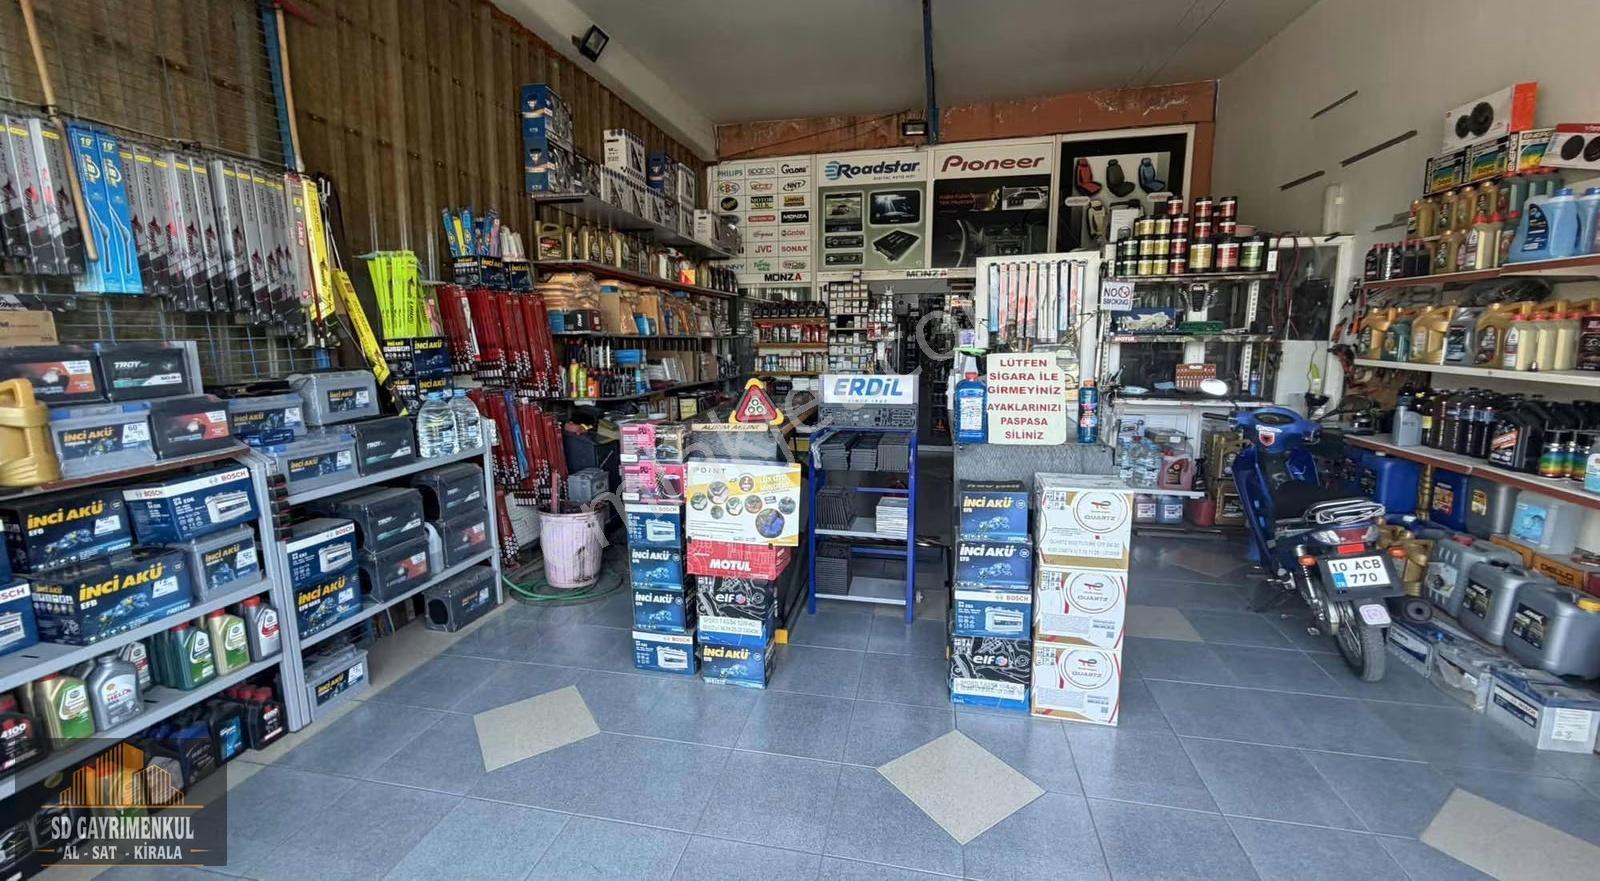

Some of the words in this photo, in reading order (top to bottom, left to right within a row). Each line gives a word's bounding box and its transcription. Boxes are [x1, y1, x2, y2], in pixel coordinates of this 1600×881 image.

[941, 155, 1045, 172] Pioneer
[717, 169, 743, 177] PHILIPS
[837, 160, 920, 179] Roadstar
[755, 245, 772, 253] JVC
[781, 245, 808, 253] SONAX
[764, 273, 802, 281] MONZA
[906, 270, 948, 278] MONZA
[1103, 287, 1118, 297] NO
[113, 360, 141, 369] TROY
[1000, 357, 1048, 367] LÜTFEN
[989, 371, 1034, 381] SİGARA
[1039, 371, 1059, 381] İLE
[987, 384, 1061, 395] GİRMEYİNİZ
[987, 403, 1062, 412] AYAKLARINIZI
[1000, 417, 1048, 426] PASPASA
[1005, 429, 1045, 440] SİLİNİZ
[221, 470, 247, 482] BOSCH
[709, 559, 752, 571] MOTUL
[1332, 563, 1348, 572] 10
[1355, 559, 1381, 570] ACB
[1350, 572, 1377, 583] 770
[0, 587, 26, 601] SCH
[716, 593, 735, 603] elf
[973, 655, 995, 665] elf
[0, 723, 27, 739] 4100
